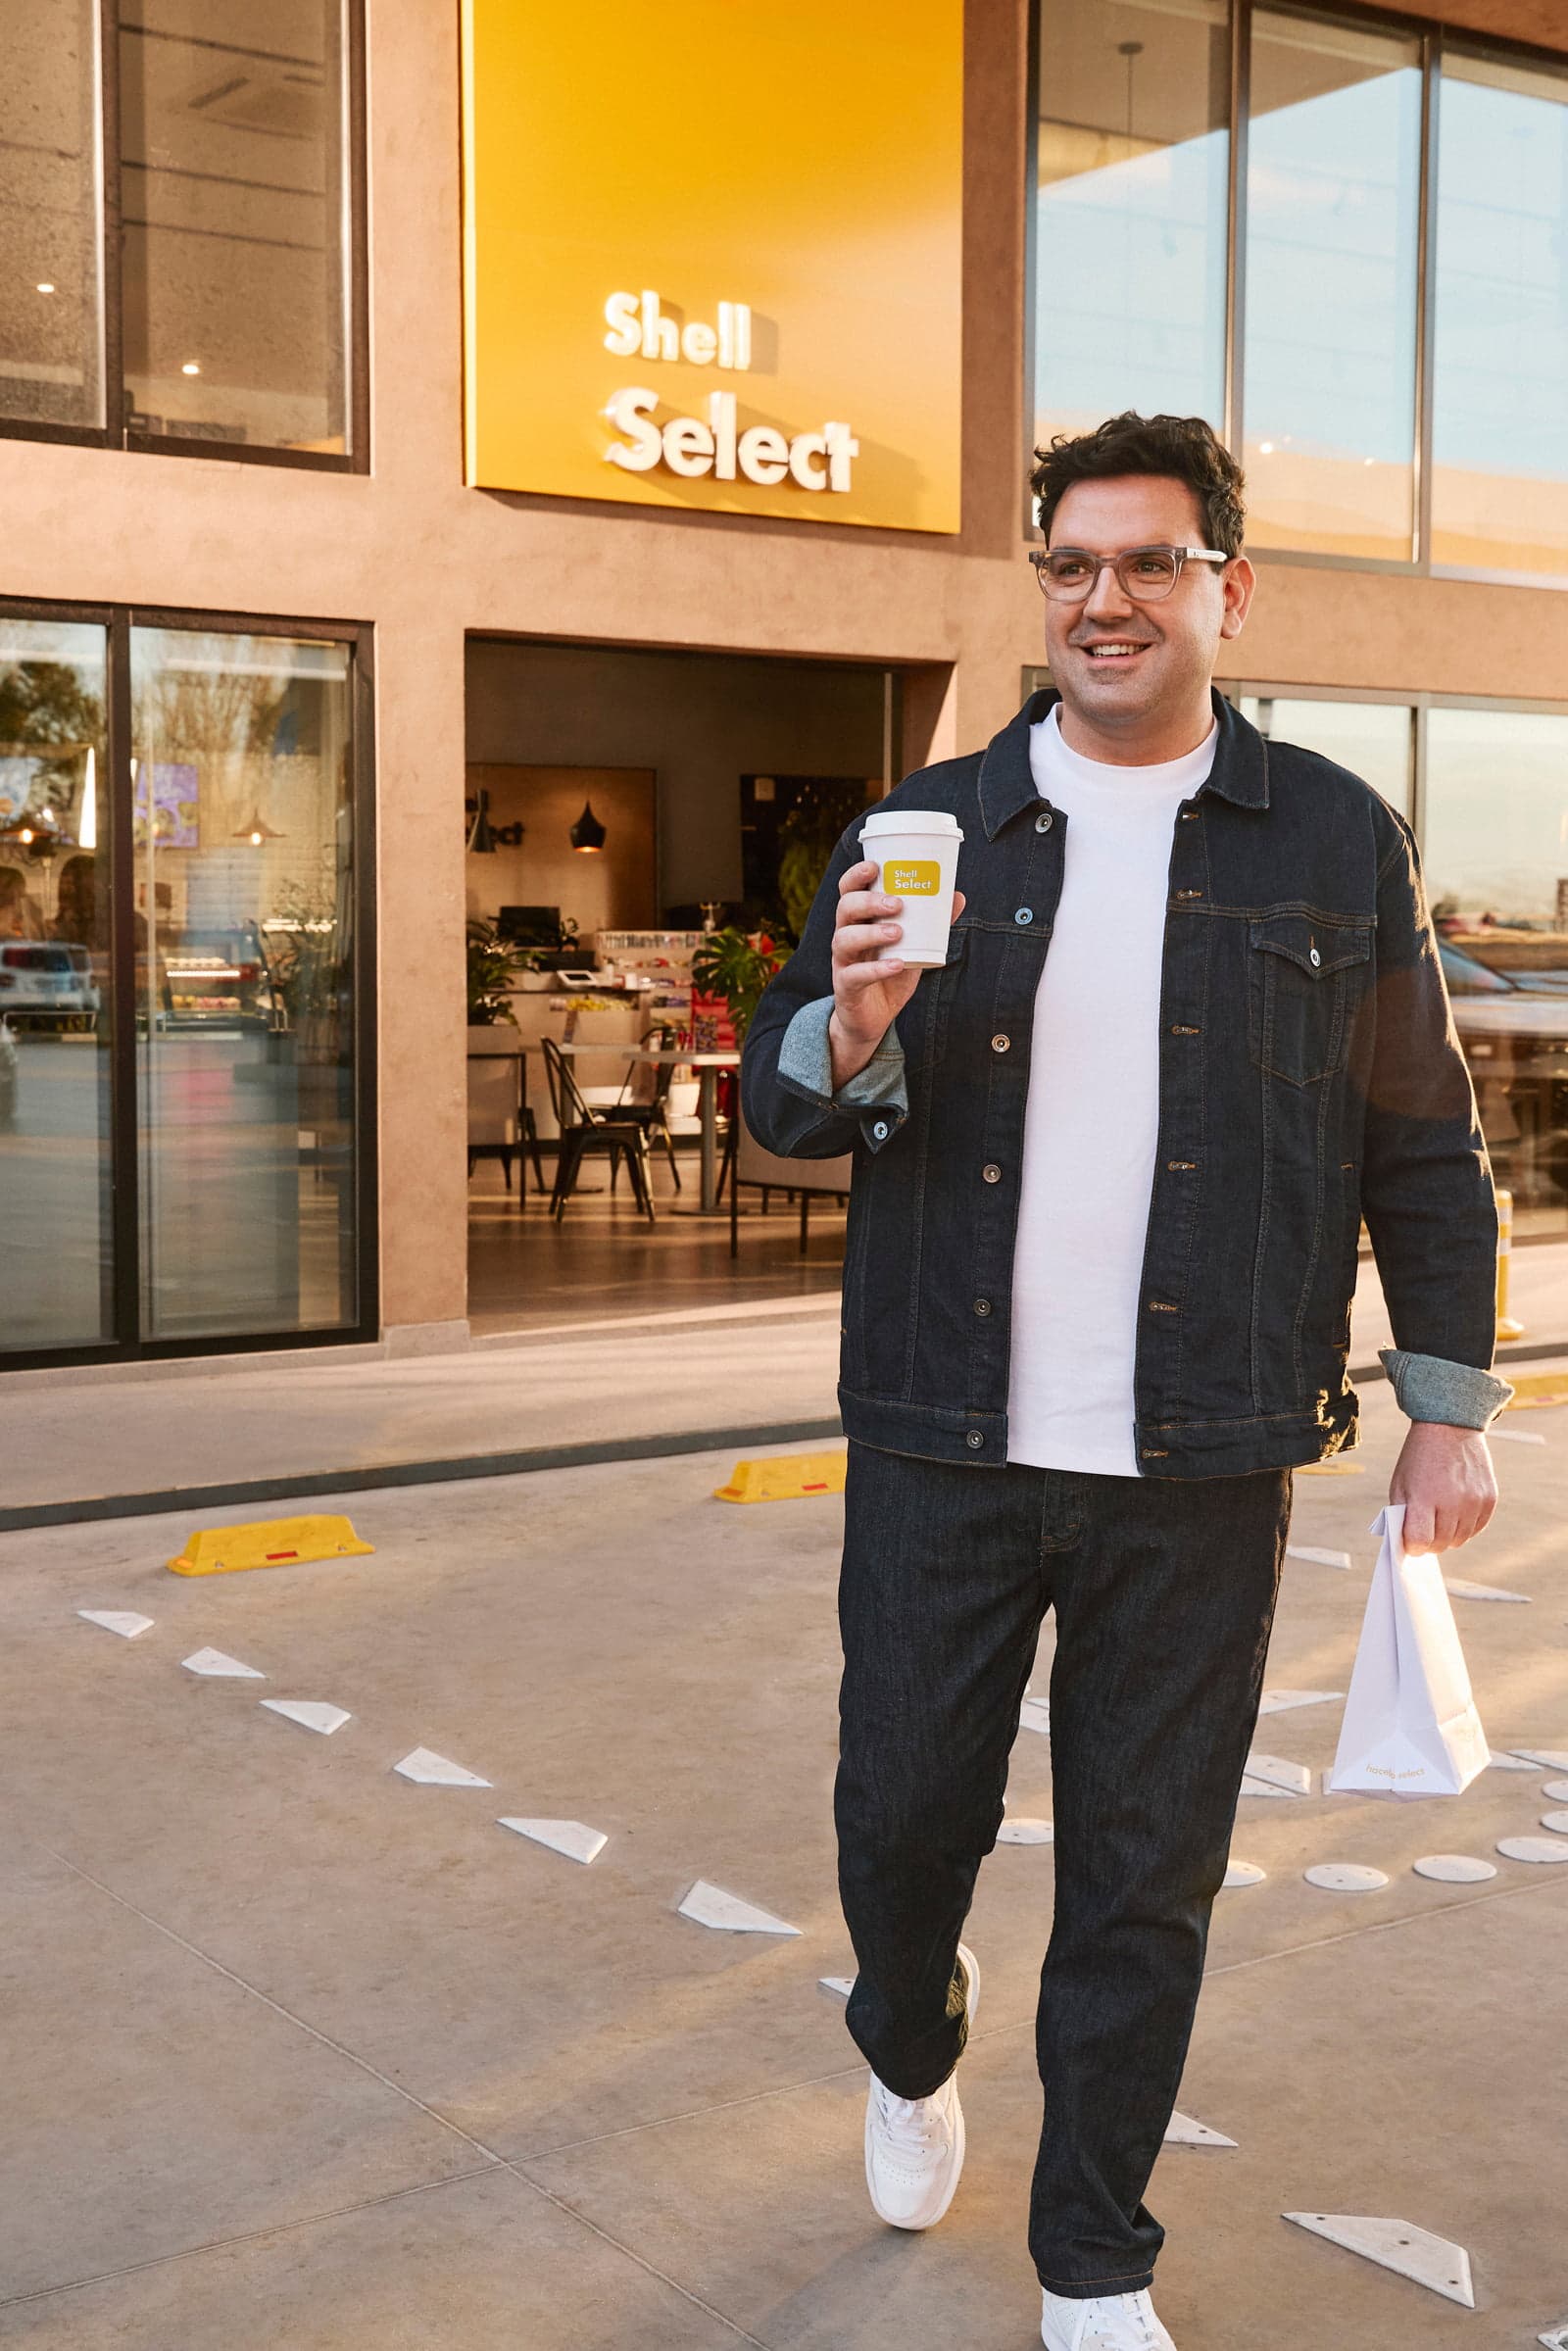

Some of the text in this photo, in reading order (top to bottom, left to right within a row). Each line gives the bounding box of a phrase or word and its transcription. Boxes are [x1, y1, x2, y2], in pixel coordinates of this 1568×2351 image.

[604, 290, 752, 371] Shell
[602, 386, 858, 493] Select
[894, 869, 917, 878] Shell
[894, 879, 932, 890] Select
